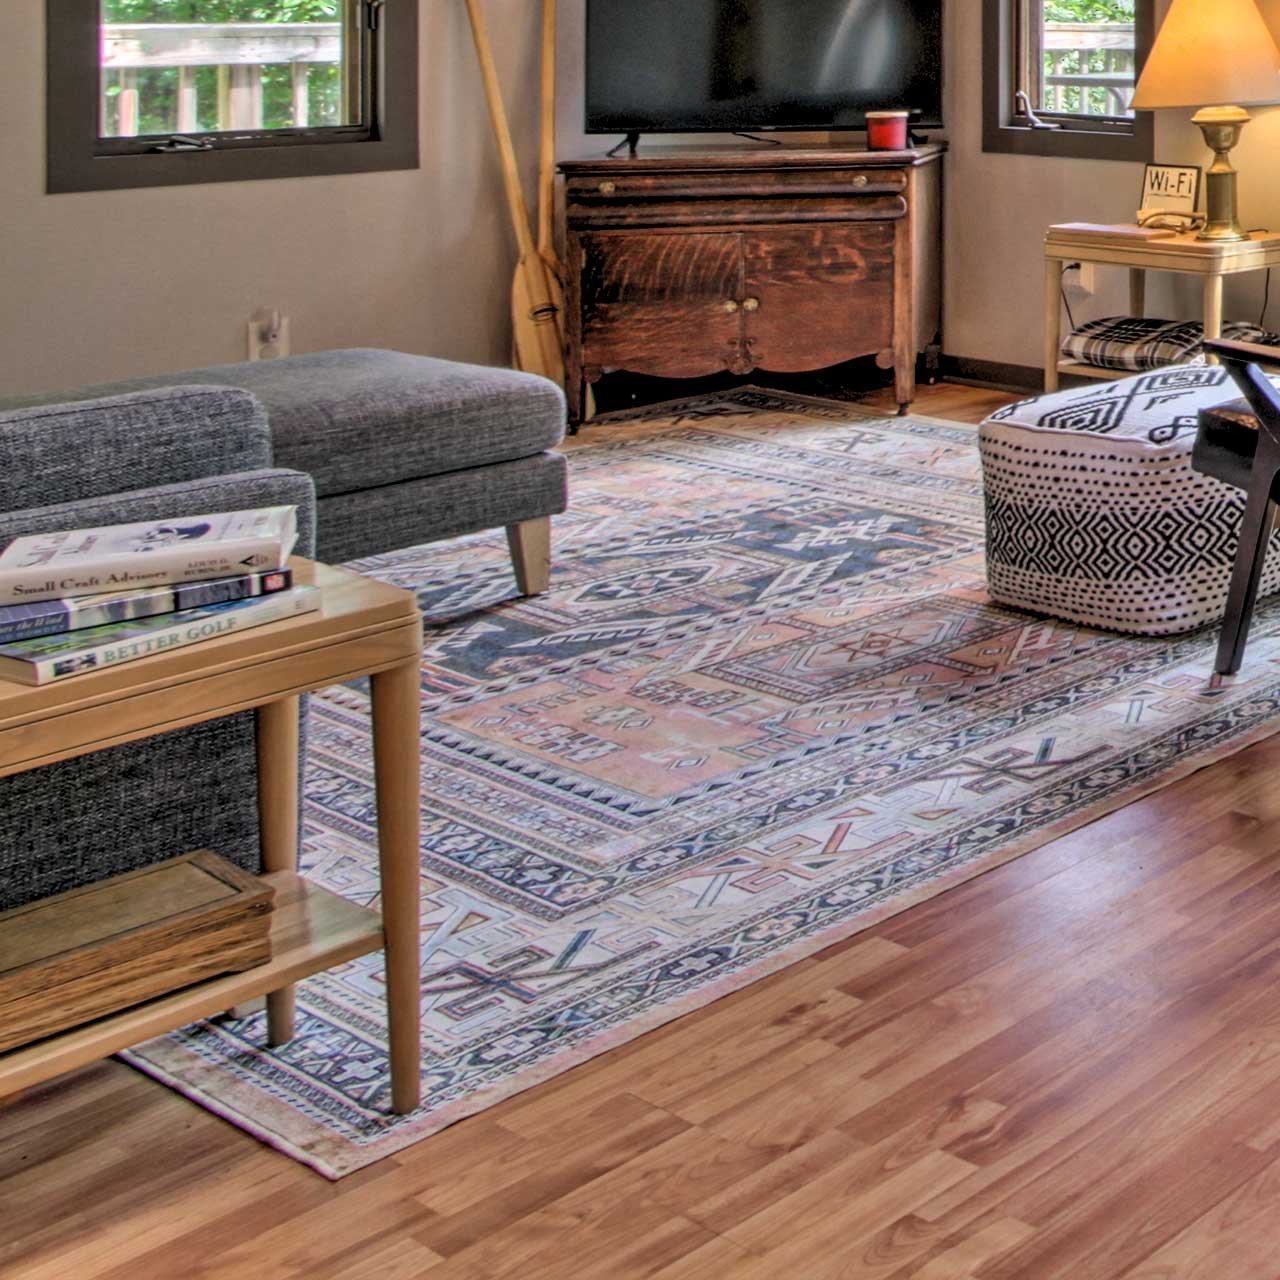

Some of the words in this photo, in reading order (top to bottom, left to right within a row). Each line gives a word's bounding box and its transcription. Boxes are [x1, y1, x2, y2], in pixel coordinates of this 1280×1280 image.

[1149, 169, 1193, 194] Wi-Fi
[12, 581, 56, 596] Small
[60, 577, 100, 590] Craft
[105, 570, 169, 585] Advisory
[103, 632, 181, 663] BETTER
[186, 616, 238, 641] GOLF
